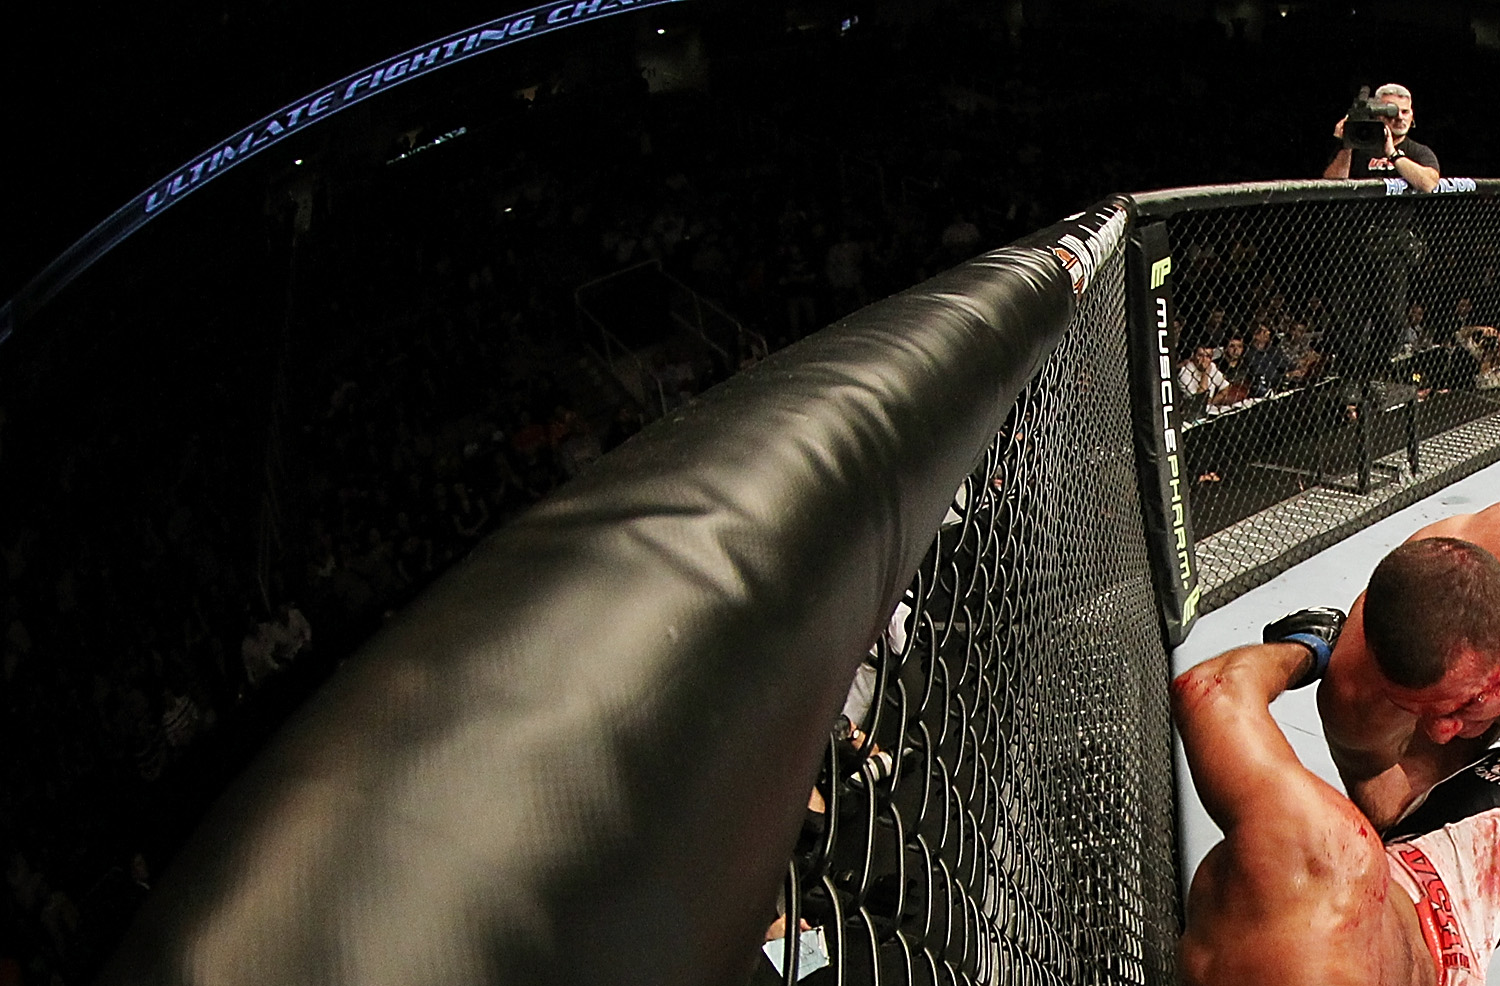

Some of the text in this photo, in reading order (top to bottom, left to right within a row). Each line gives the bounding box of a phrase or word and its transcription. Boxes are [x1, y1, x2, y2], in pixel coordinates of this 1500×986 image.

[145, 91, 335, 212] ULTIMATE
[343, 15, 536, 100] FIGHTING
[1383, 178, 1408, 195] HP
